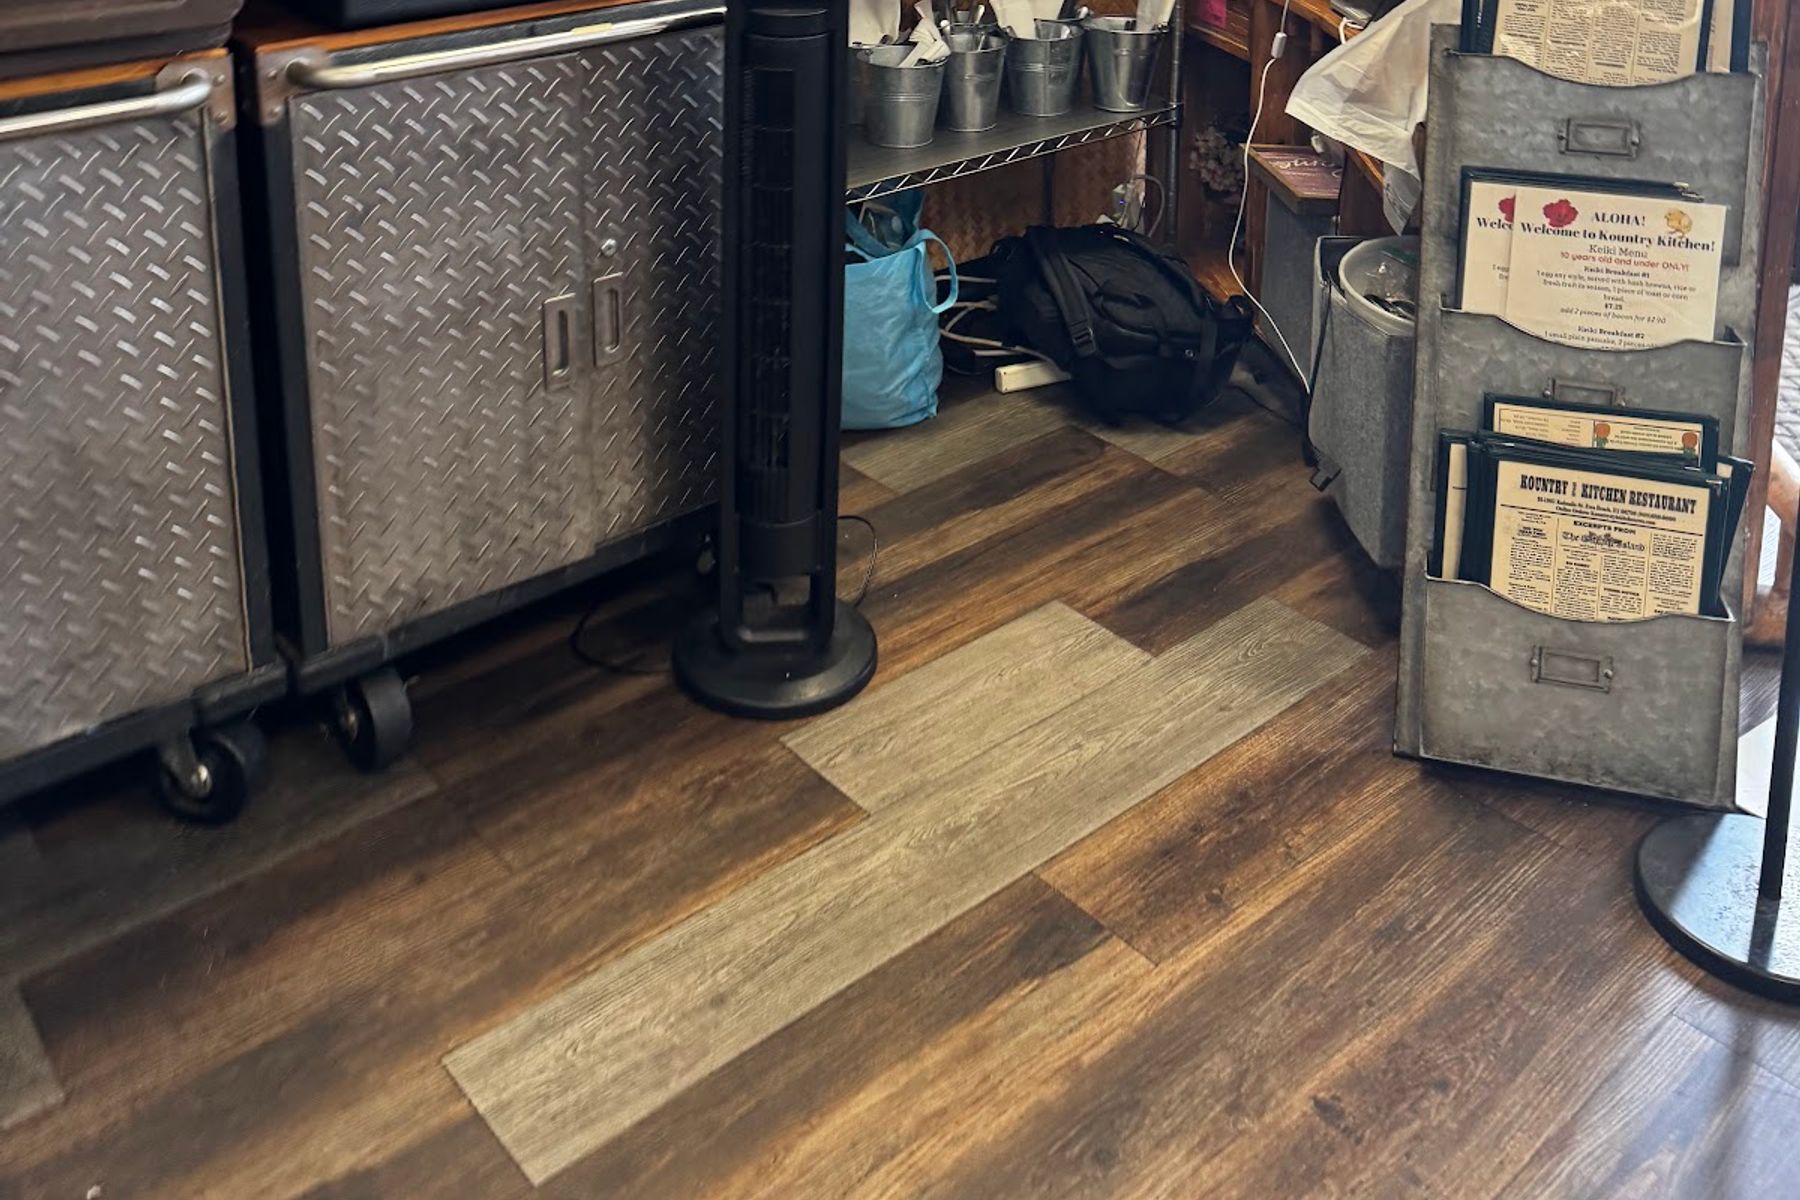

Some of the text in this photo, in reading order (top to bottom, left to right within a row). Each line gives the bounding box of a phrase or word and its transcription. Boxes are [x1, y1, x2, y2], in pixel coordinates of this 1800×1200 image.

[1591, 211, 1646, 227] ALOHA!
[1520, 221, 1715, 252] Welcome to Kountry Kitchen!
[1588, 244, 1648, 258] Keiki Menu
[1560, 251, 1689, 272] 10 years old and under ONLY!
[1605, 267, 1640, 278] Breakfast
[1599, 328, 1634, 339] Breakfast
[1520, 474, 1569, 495] KOUNTRY
[1581, 483, 1627, 504] KITCHEN
[1629, 490, 1697, 514] RESTAURANT
[1573, 520, 1636, 536] EXCERPTS FROM
